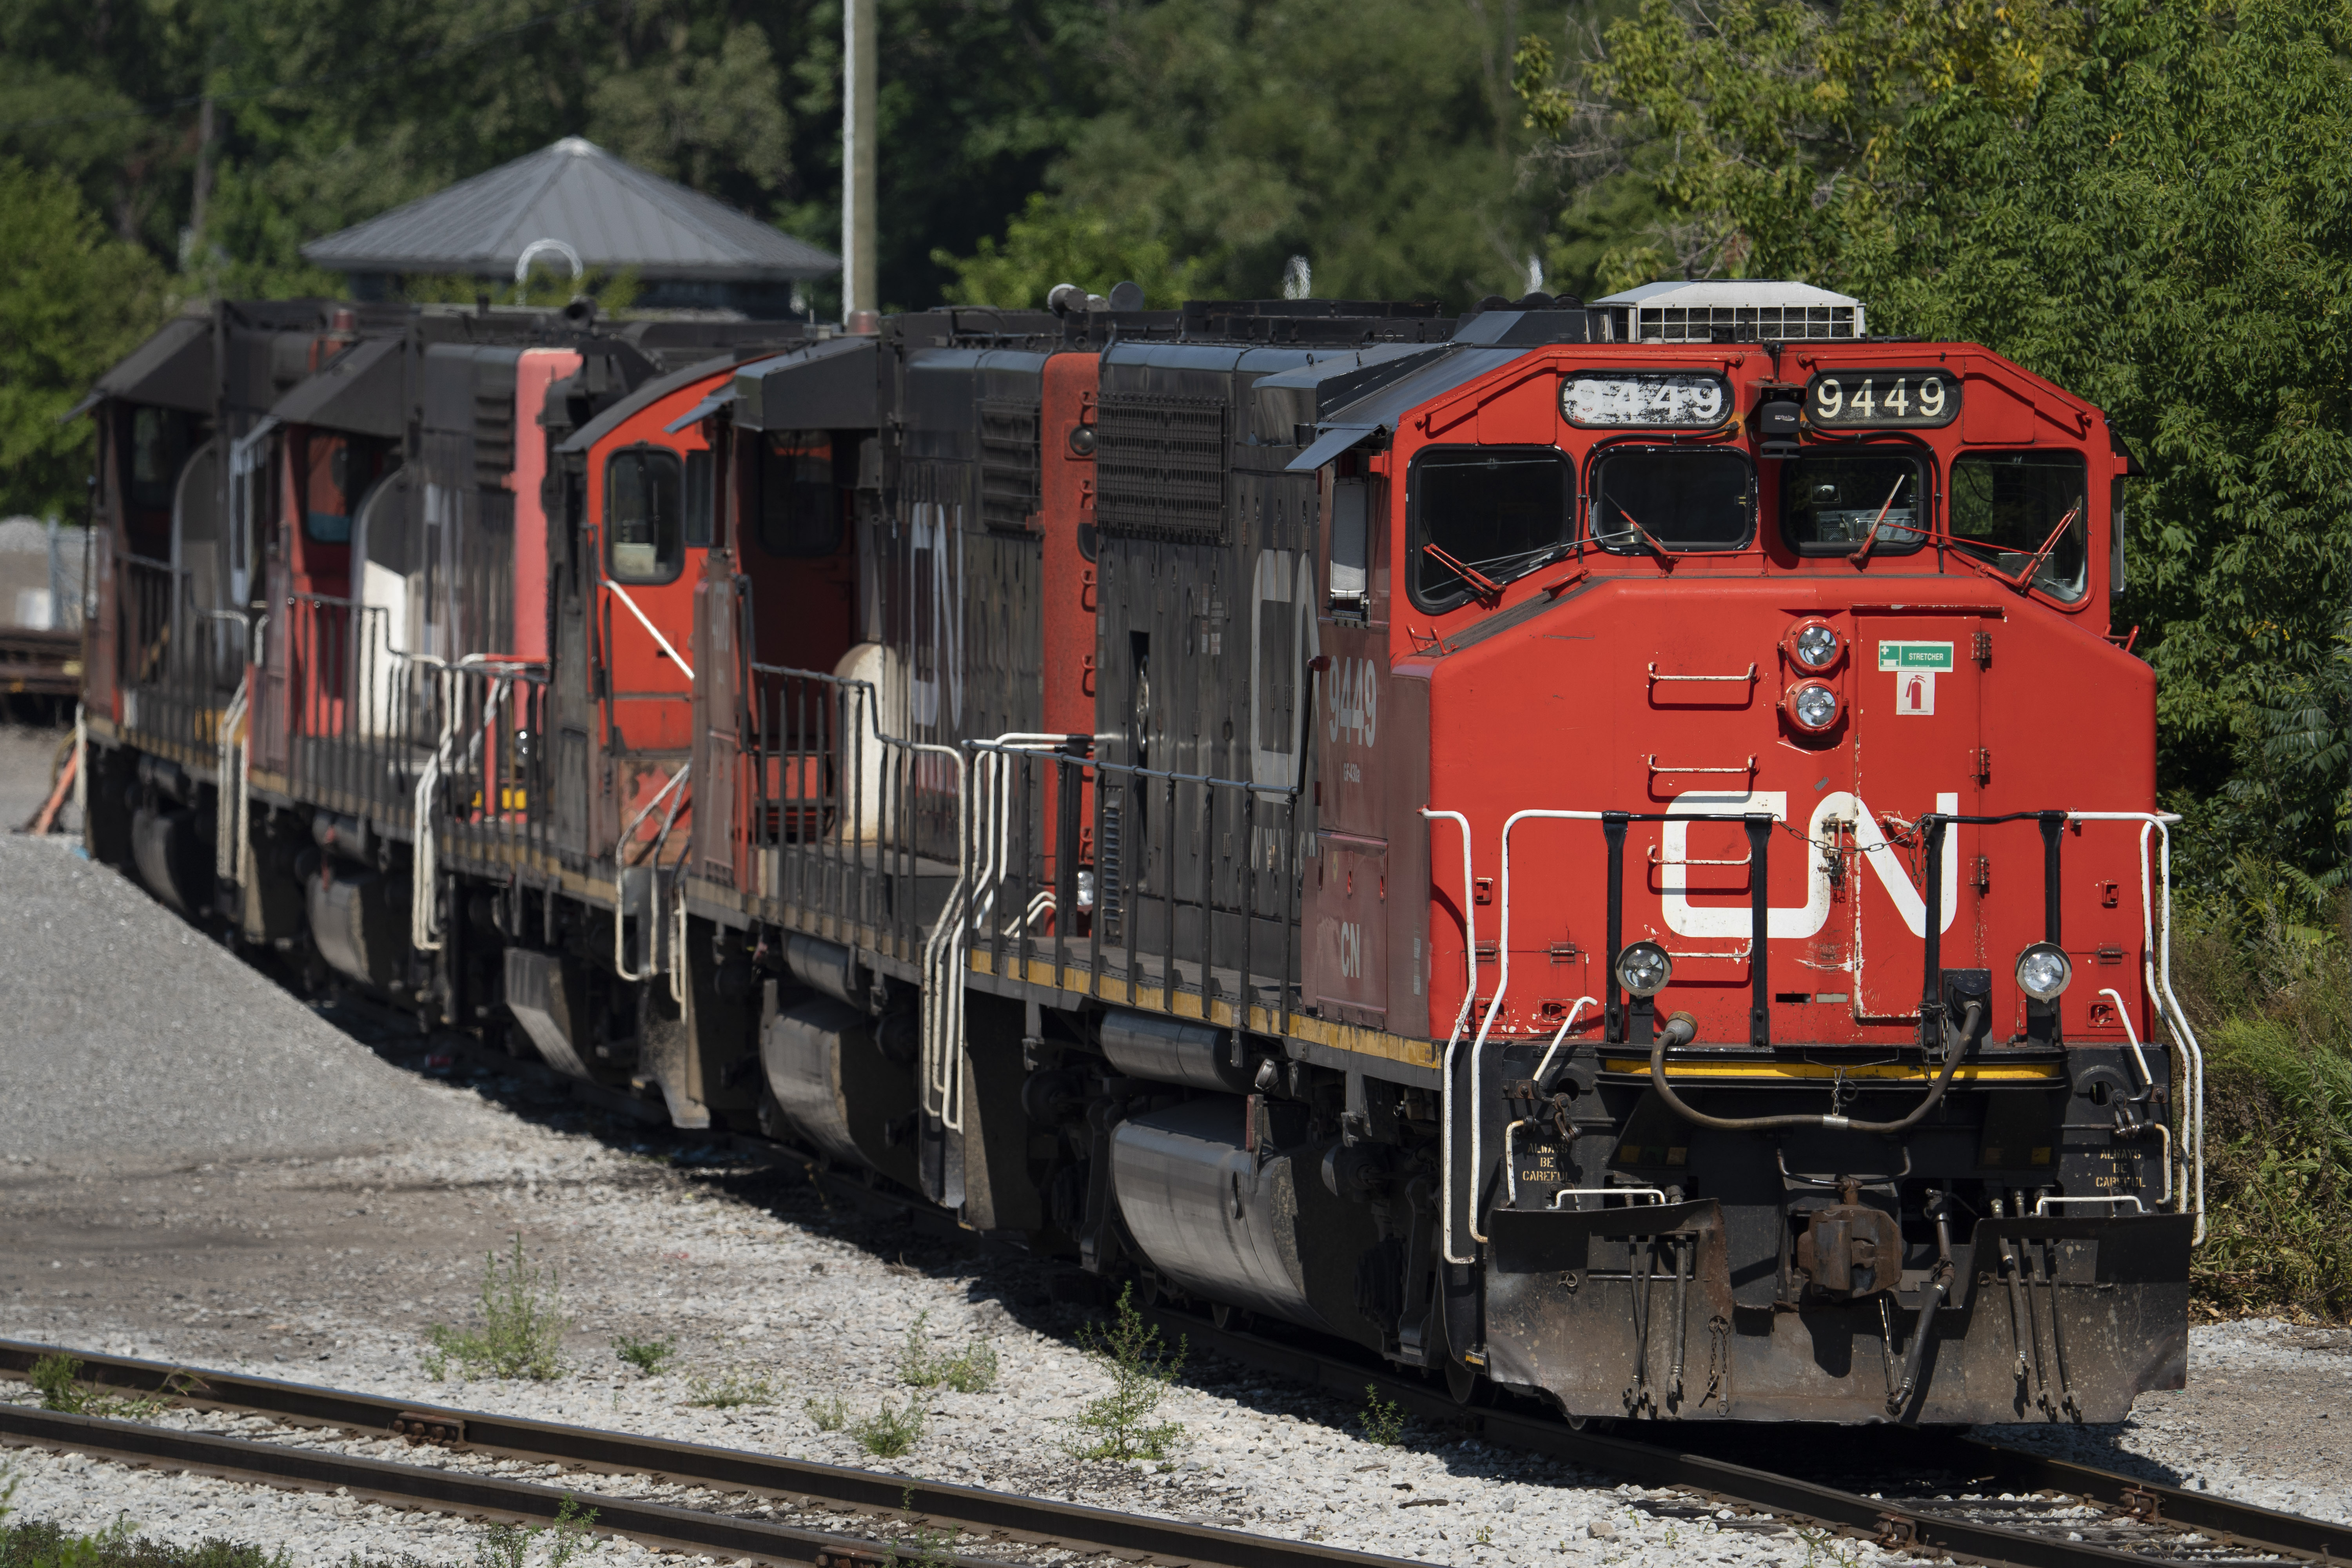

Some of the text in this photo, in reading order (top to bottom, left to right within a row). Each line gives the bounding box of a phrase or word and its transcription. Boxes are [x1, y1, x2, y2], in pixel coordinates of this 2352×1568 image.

[1573, 377, 1722, 419] 9449
[1817, 377, 1945, 418] 9449
[910, 502, 964, 731] CN
[1909, 653, 1944, 661] STRETCHER
[1329, 655, 1376, 748] 9449
[1343, 763, 1360, 783] GF-430a
[1662, 791, 1958, 938] CN
[1341, 921, 1360, 978] CN
[1528, 1143, 1568, 1154] ALWAYS
[2100, 1149, 2141, 1160] ALWAYS
[1540, 1157, 1554, 1168] BE
[2113, 1163, 2128, 1173] BE
[1523, 1171, 1572, 1181] CAREFUL
[2096, 1177, 2146, 1188] CAREFUL
